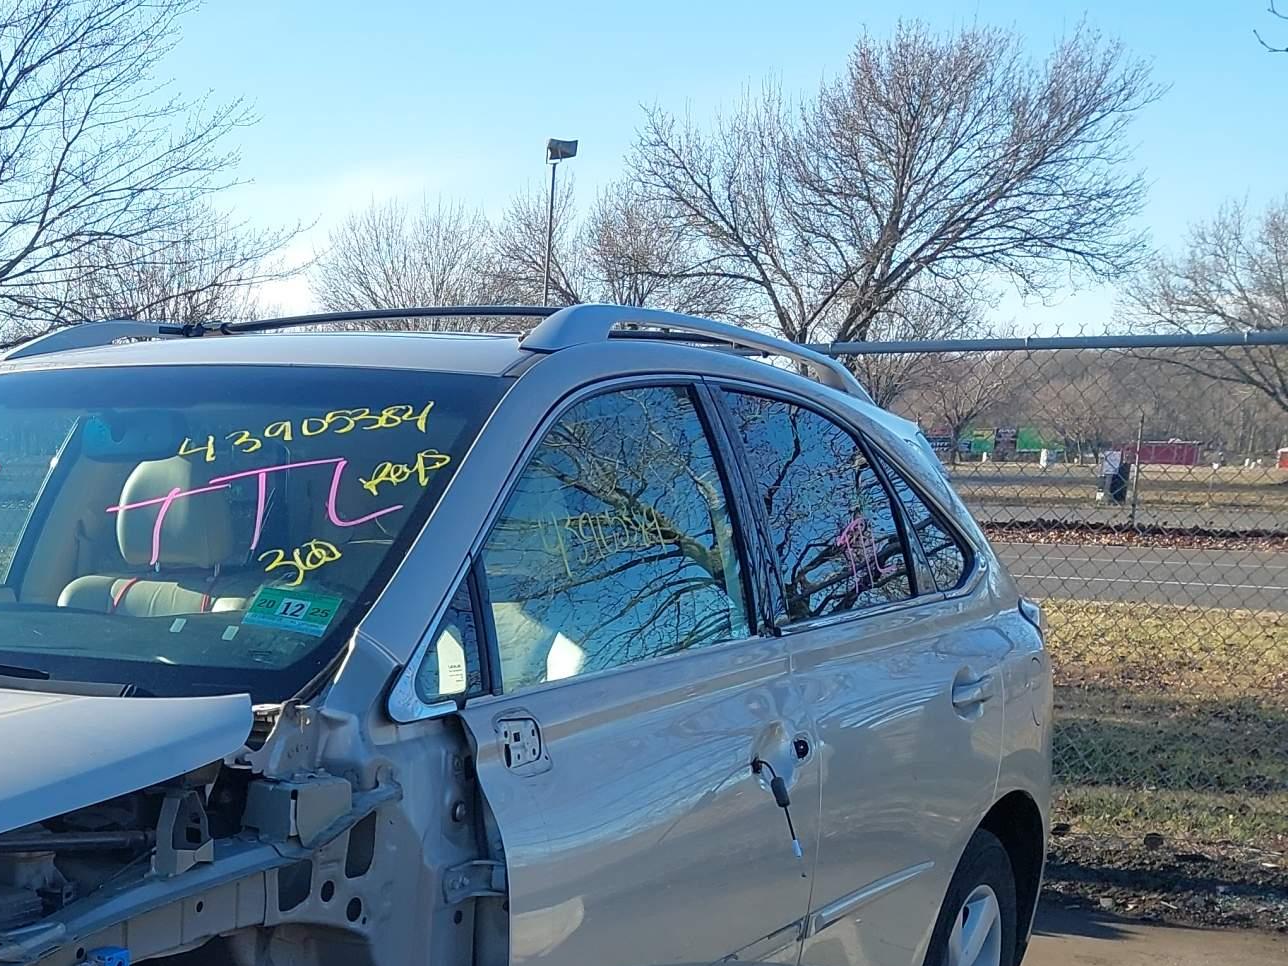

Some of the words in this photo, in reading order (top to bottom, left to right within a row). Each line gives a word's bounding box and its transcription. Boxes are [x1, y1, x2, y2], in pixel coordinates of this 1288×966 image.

[178, 400, 435, 463] 43905384
[257, 598, 276, 610] 20
[279, 601, 305, 618] 12
[310, 607, 331, 618] 25
